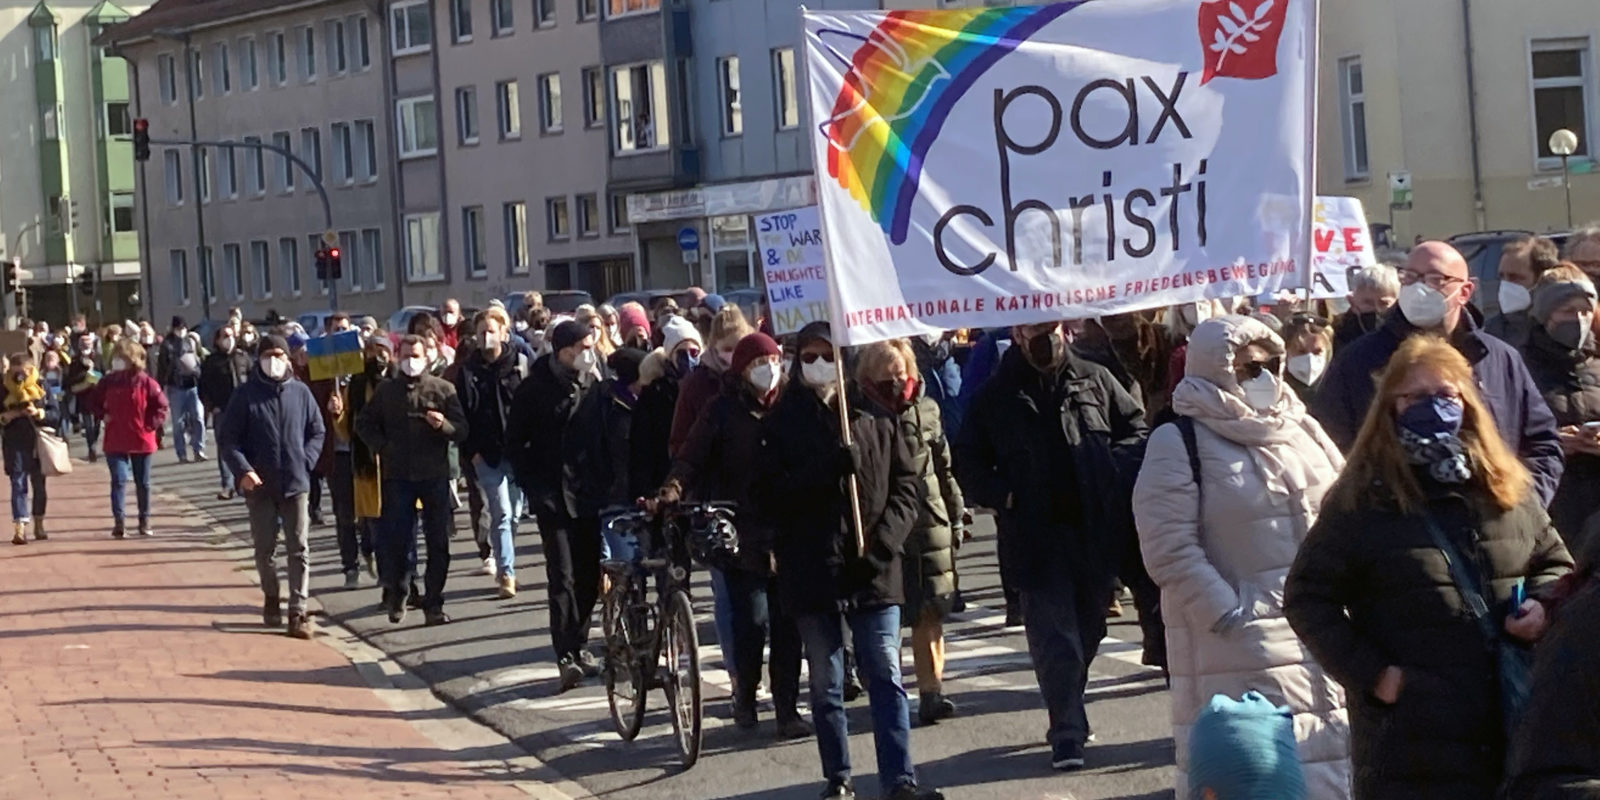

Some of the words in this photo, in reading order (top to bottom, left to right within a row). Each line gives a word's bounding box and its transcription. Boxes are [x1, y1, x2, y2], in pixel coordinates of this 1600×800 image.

[994, 72, 1192, 175] pax
[760, 214, 797, 231] STOP
[933, 159, 1207, 276] christi
[789, 229, 822, 247] WAR
[767, 248, 781, 265] &
[766, 265, 826, 283] ENLIGHTE
[770, 285, 804, 302] LIKE
[846, 297, 985, 328] INTERNATIONALE
[995, 285, 1116, 312] KATHOLISCHE
[1124, 258, 1296, 297] FRIEDENSBEWEGUNG
